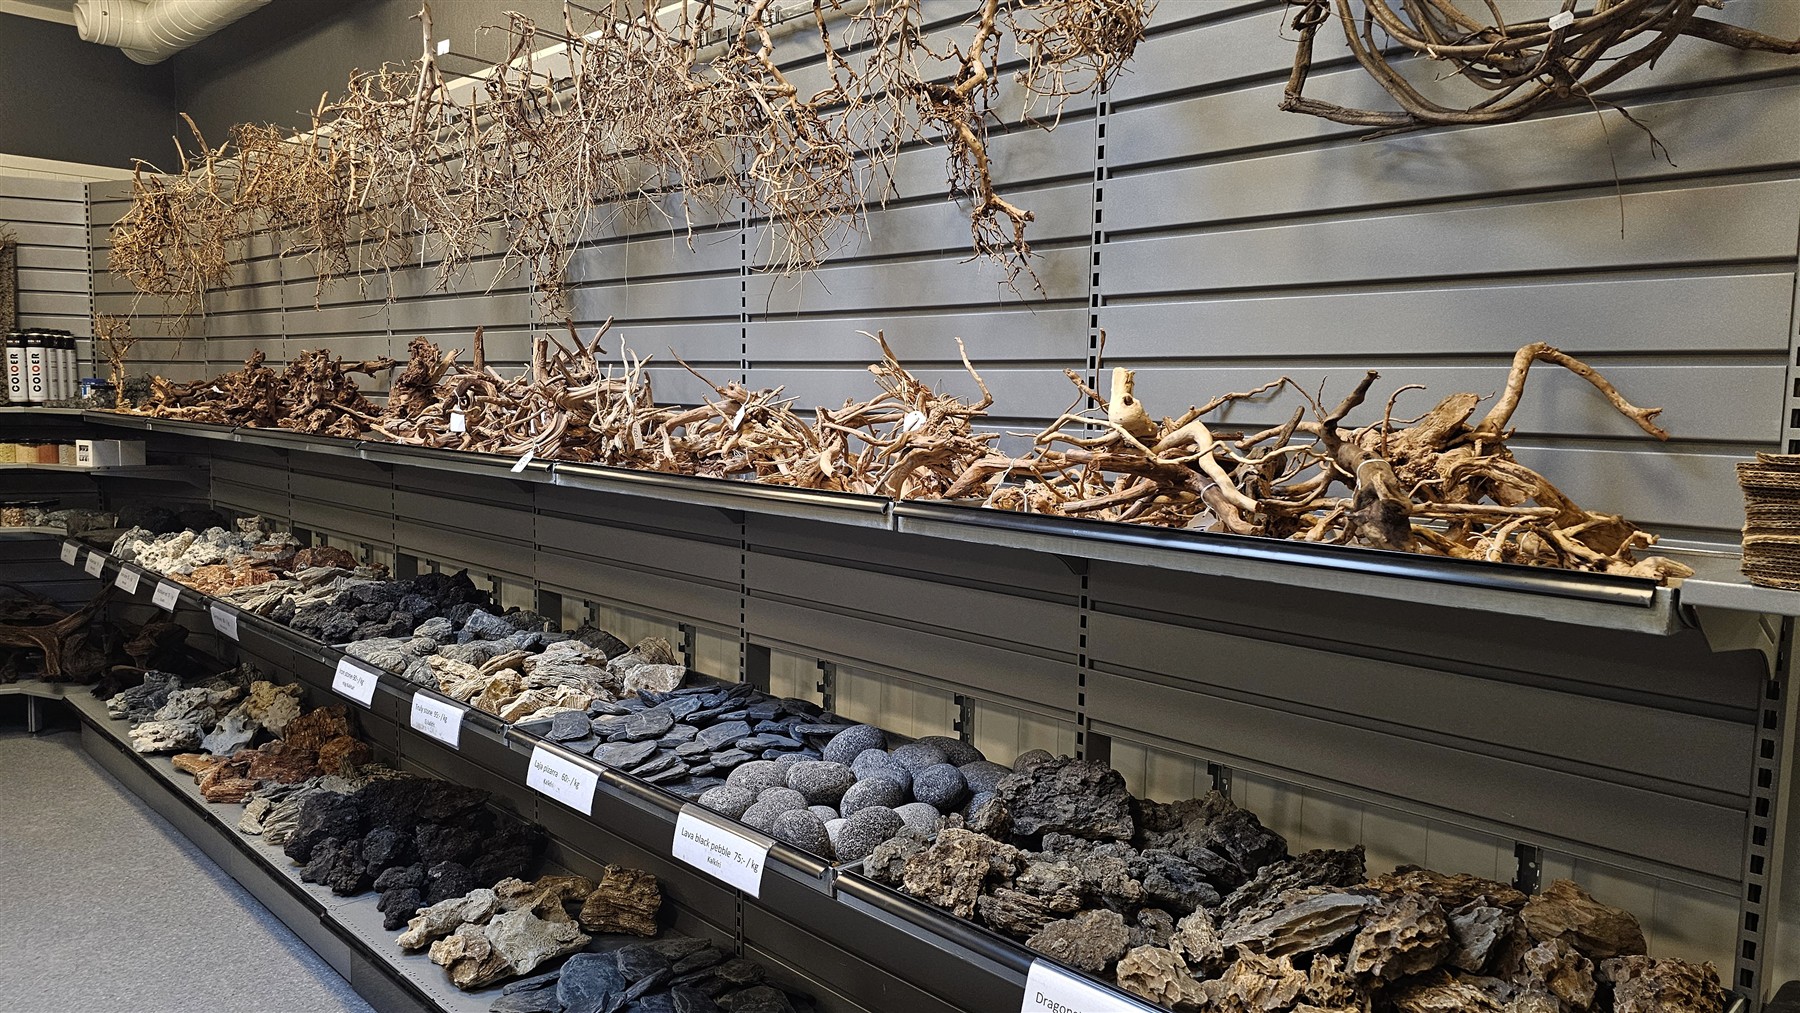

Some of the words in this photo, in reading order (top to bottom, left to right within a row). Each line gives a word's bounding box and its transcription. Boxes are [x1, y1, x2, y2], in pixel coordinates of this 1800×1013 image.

[10, 353, 20, 392] COLOER
[31, 353, 41, 392] COLOER
[542, 764, 559, 778] pizarra
[573, 778, 581, 790] kg
[681, 827, 694, 840] Lava
[694, 832, 711, 848] black
[710, 841, 731, 858] pebble
[733, 851, 746, 865] 75:-
[750, 859, 759, 874] kg
